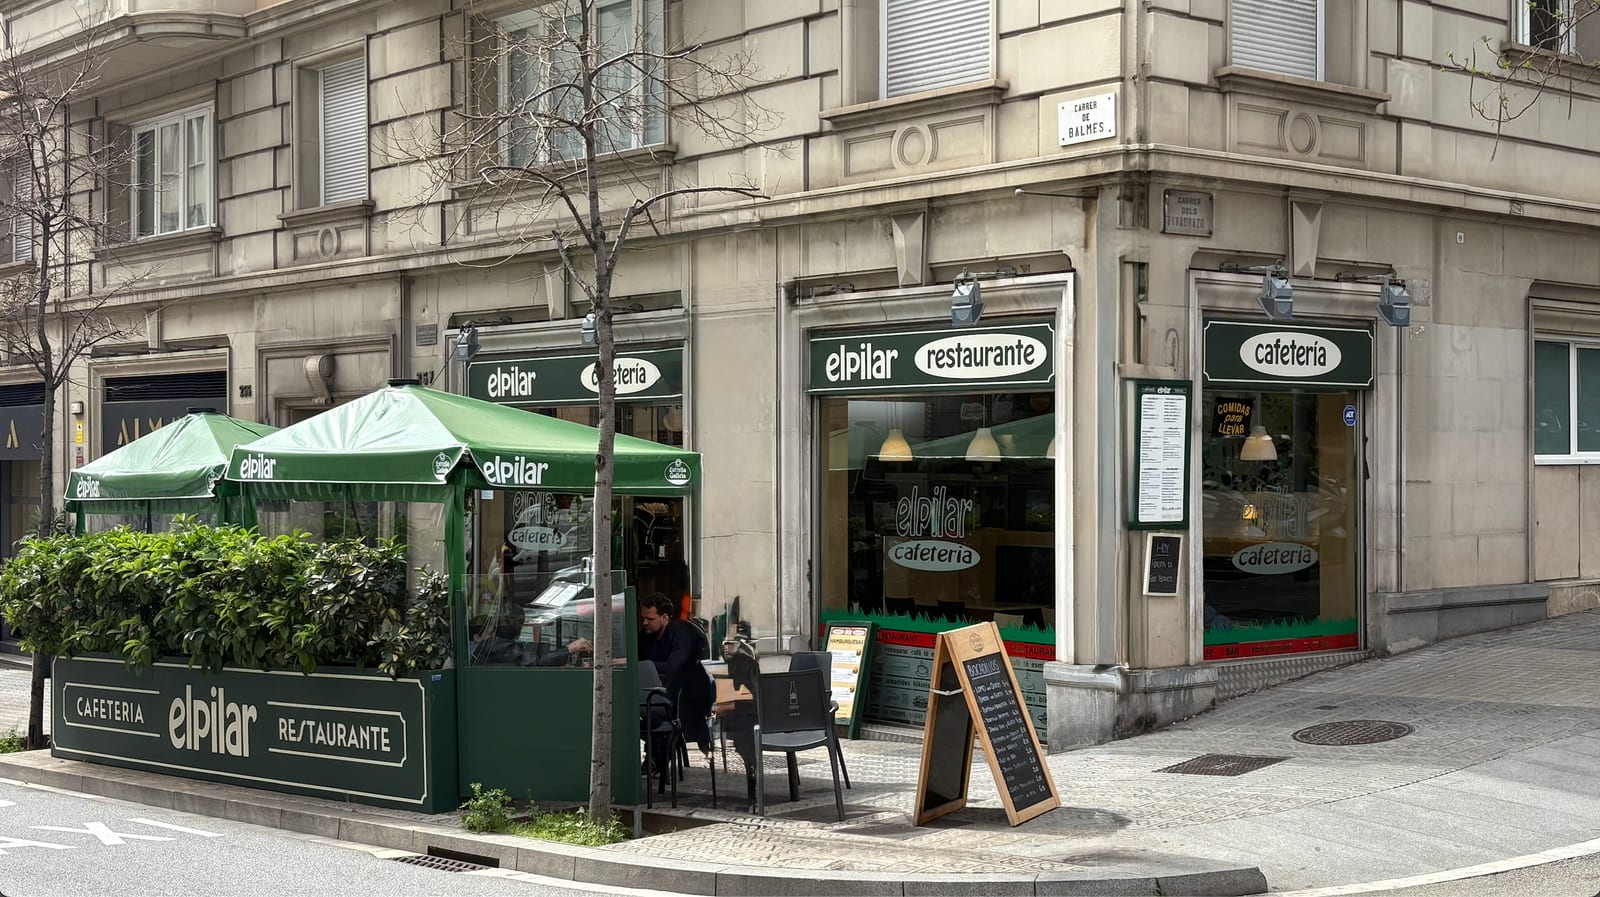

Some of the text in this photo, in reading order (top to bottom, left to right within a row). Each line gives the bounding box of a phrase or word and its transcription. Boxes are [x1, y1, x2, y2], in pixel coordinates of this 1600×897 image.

[1074, 101, 1097, 112] CARRER
[1082, 113, 1090, 122] DE
[1068, 122, 1104, 138] BALMES
[927, 339, 1035, 369] restaurante
[1255, 338, 1327, 366] cafetería
[591, 363, 646, 391] cetería
[1217, 402, 1250, 416] COMIDAS
[1224, 414, 1243, 424] para
[1218, 423, 1245, 435] LLEVAR
[894, 544, 972, 564] cafeteria
[1239, 547, 1312, 566] cafeteria
[76, 696, 144, 724] CAFETERIA
[279, 717, 391, 753] RESTAURANTE
